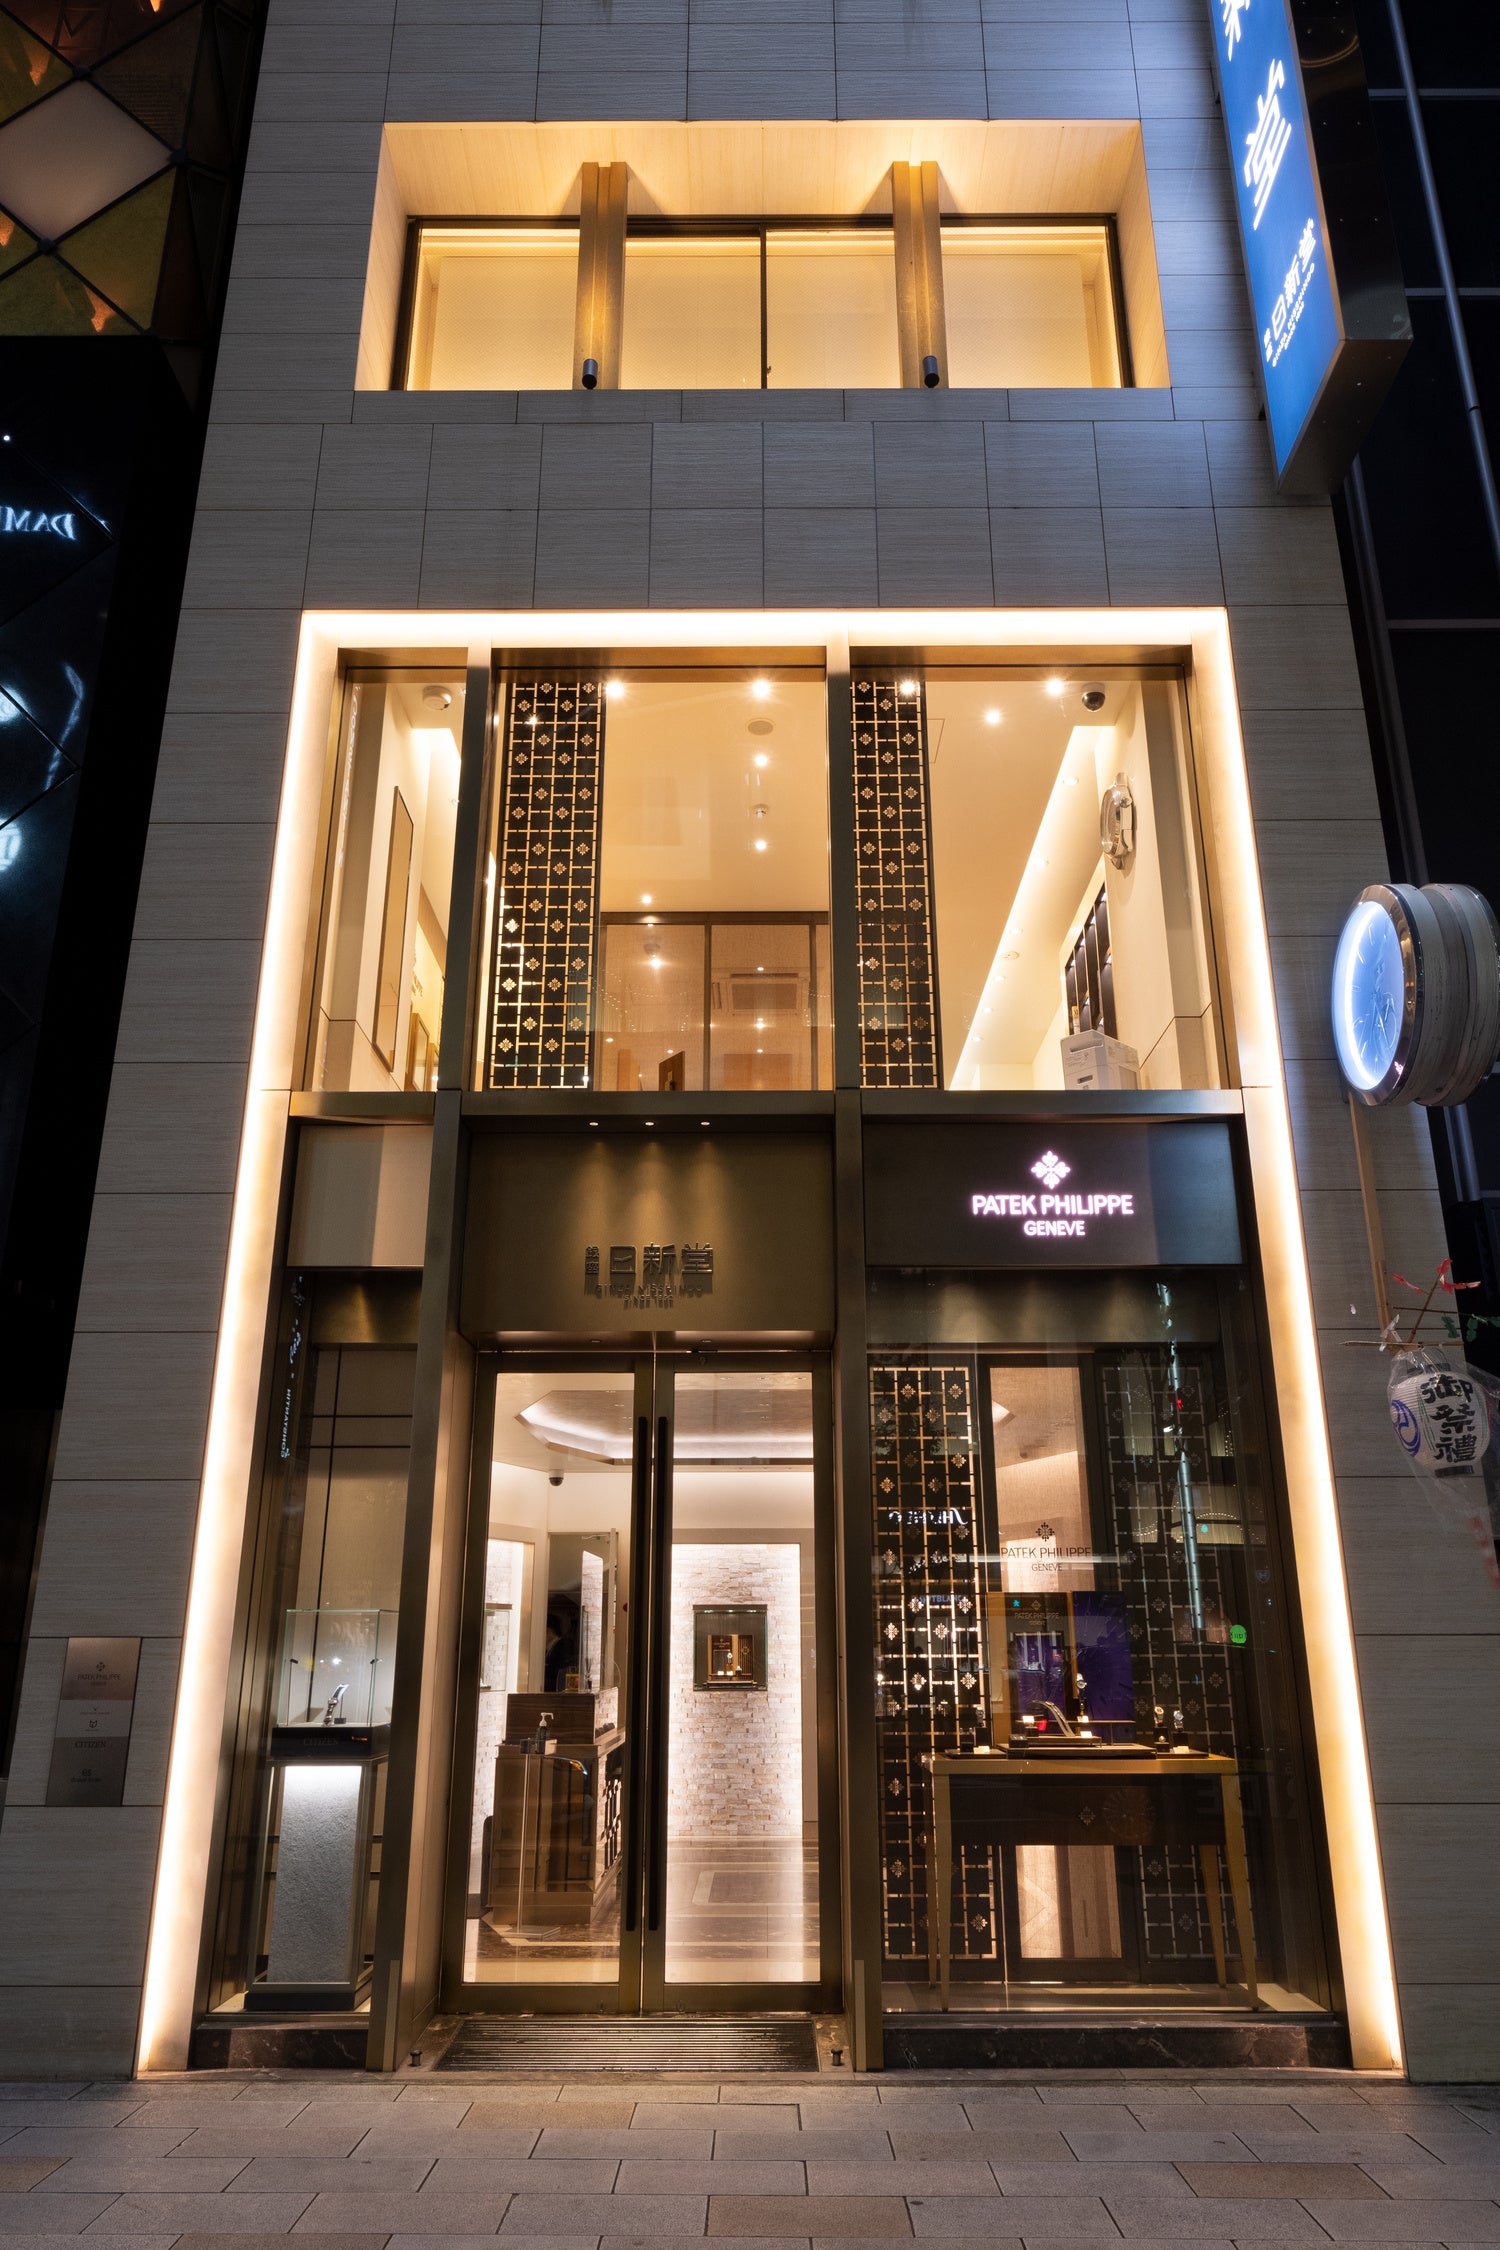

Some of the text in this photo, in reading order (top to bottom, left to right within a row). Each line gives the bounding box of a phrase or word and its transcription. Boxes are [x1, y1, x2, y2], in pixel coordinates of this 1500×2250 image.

[972, 1194, 1134, 1215] PATEK PHILIPPE
[1023, 1220, 1086, 1236] GENEVE
[1420, 1374, 1477, 1463] 御祭禮
[1001, 1547, 1091, 1558] PATEK PHILIPPE
[1031, 1563, 1063, 1572] GENEVE
